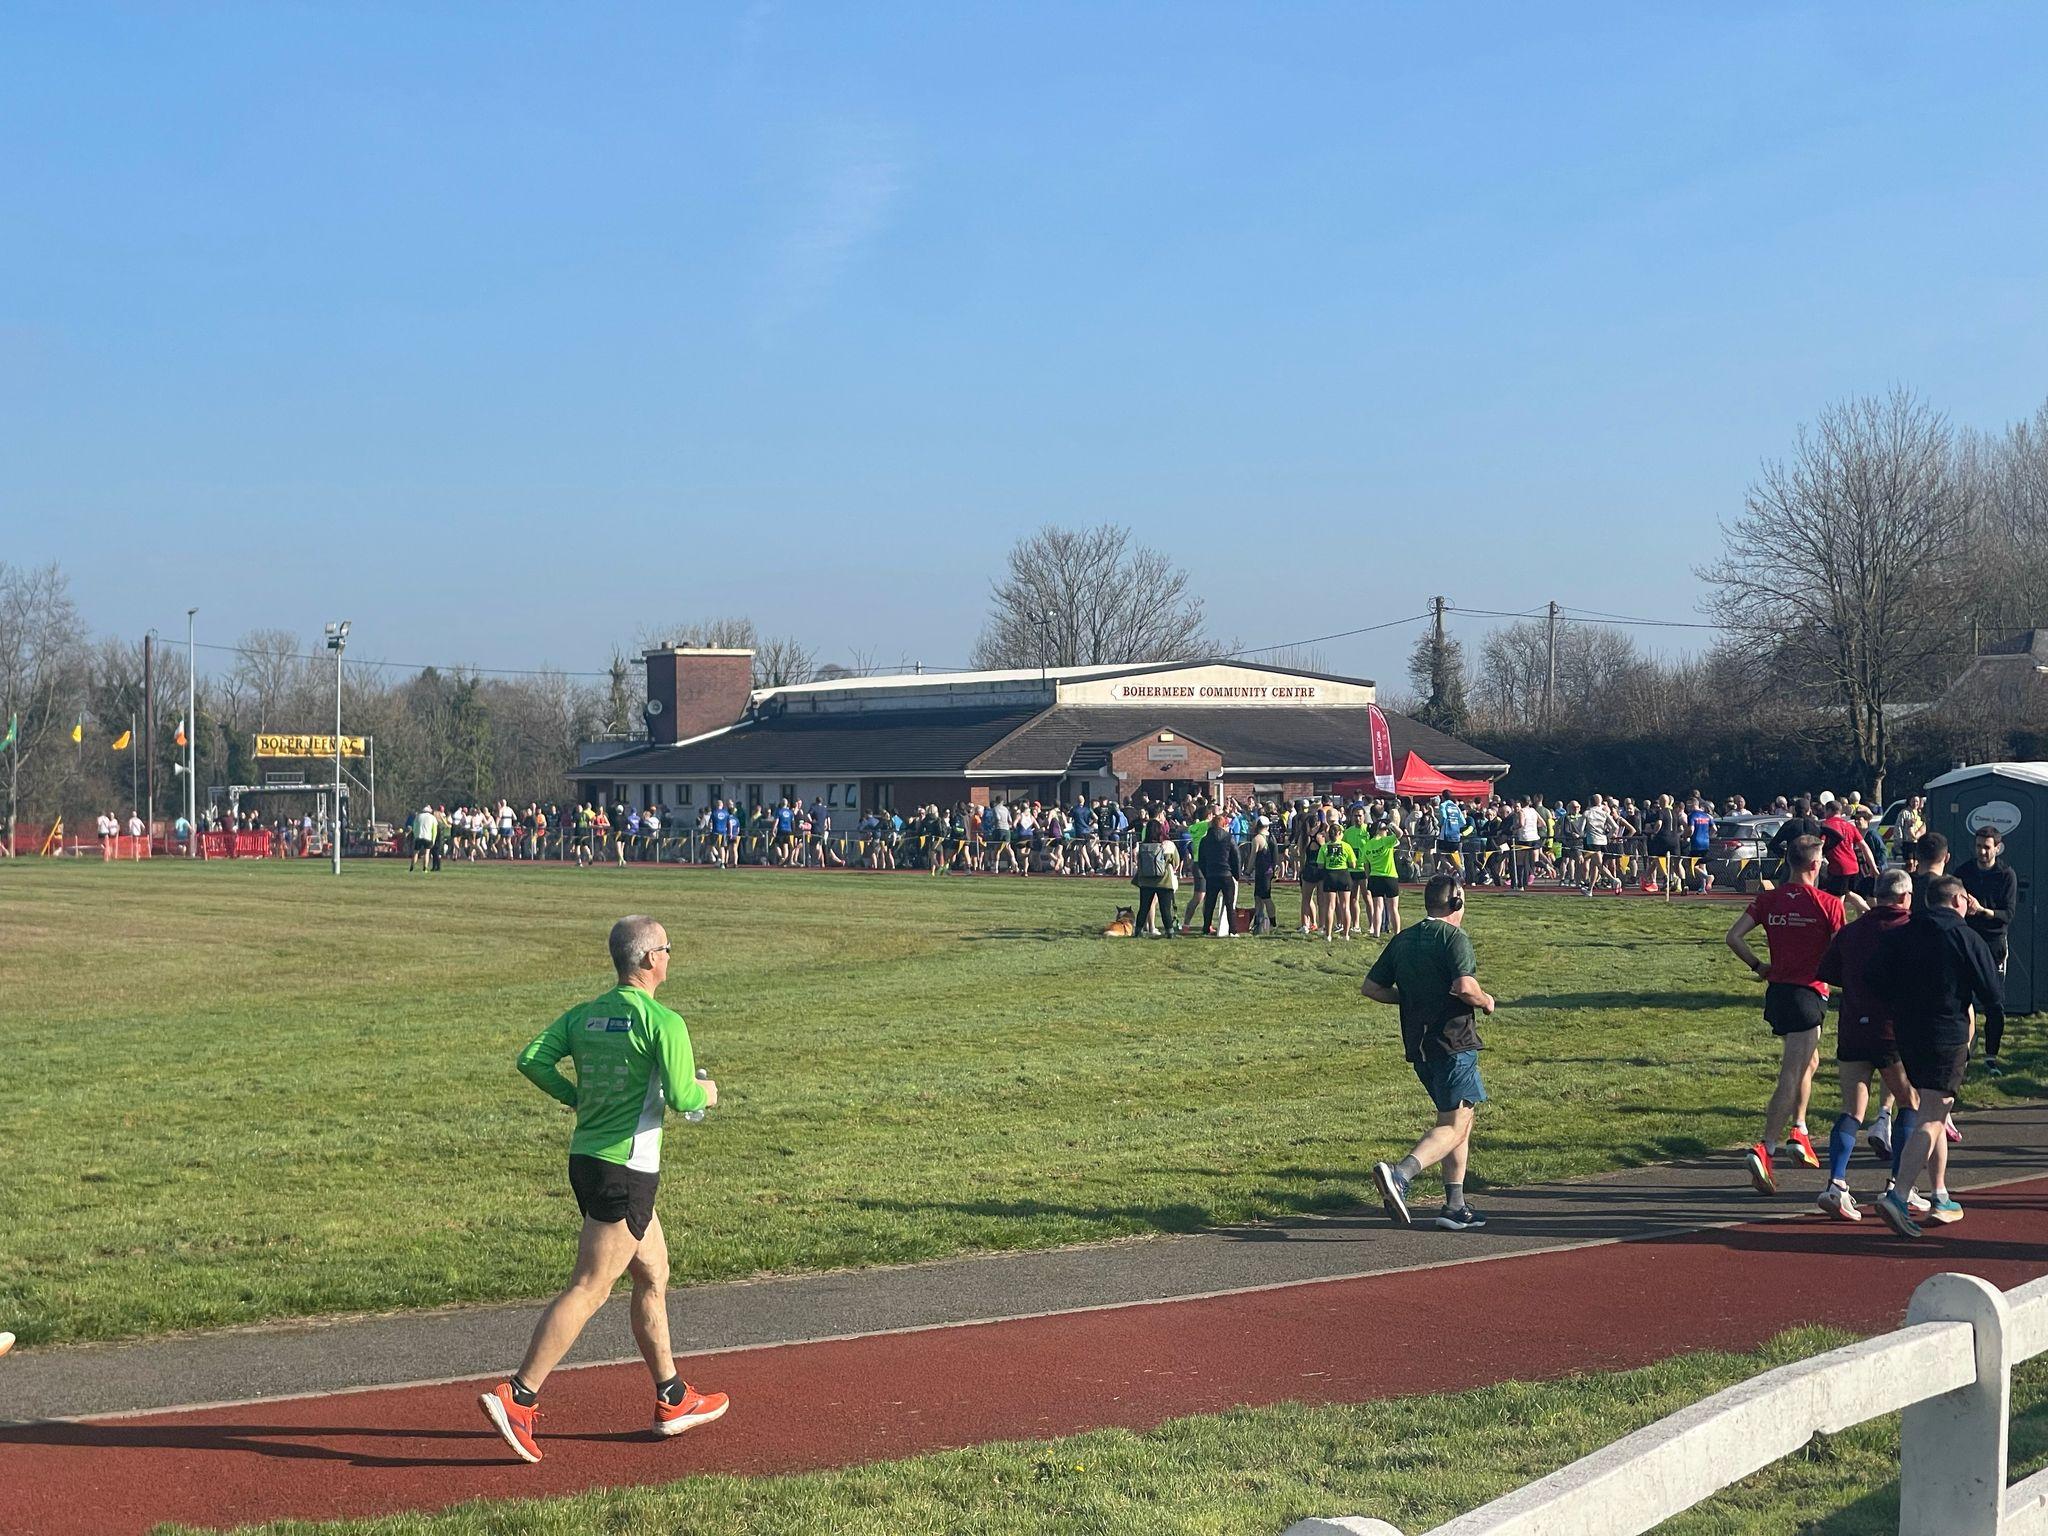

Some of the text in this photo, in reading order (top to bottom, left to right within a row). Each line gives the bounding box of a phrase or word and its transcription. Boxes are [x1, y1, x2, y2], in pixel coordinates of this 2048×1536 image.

[1122, 686, 1315, 698] BOHERMEEN COMMUNITY CENTRE
